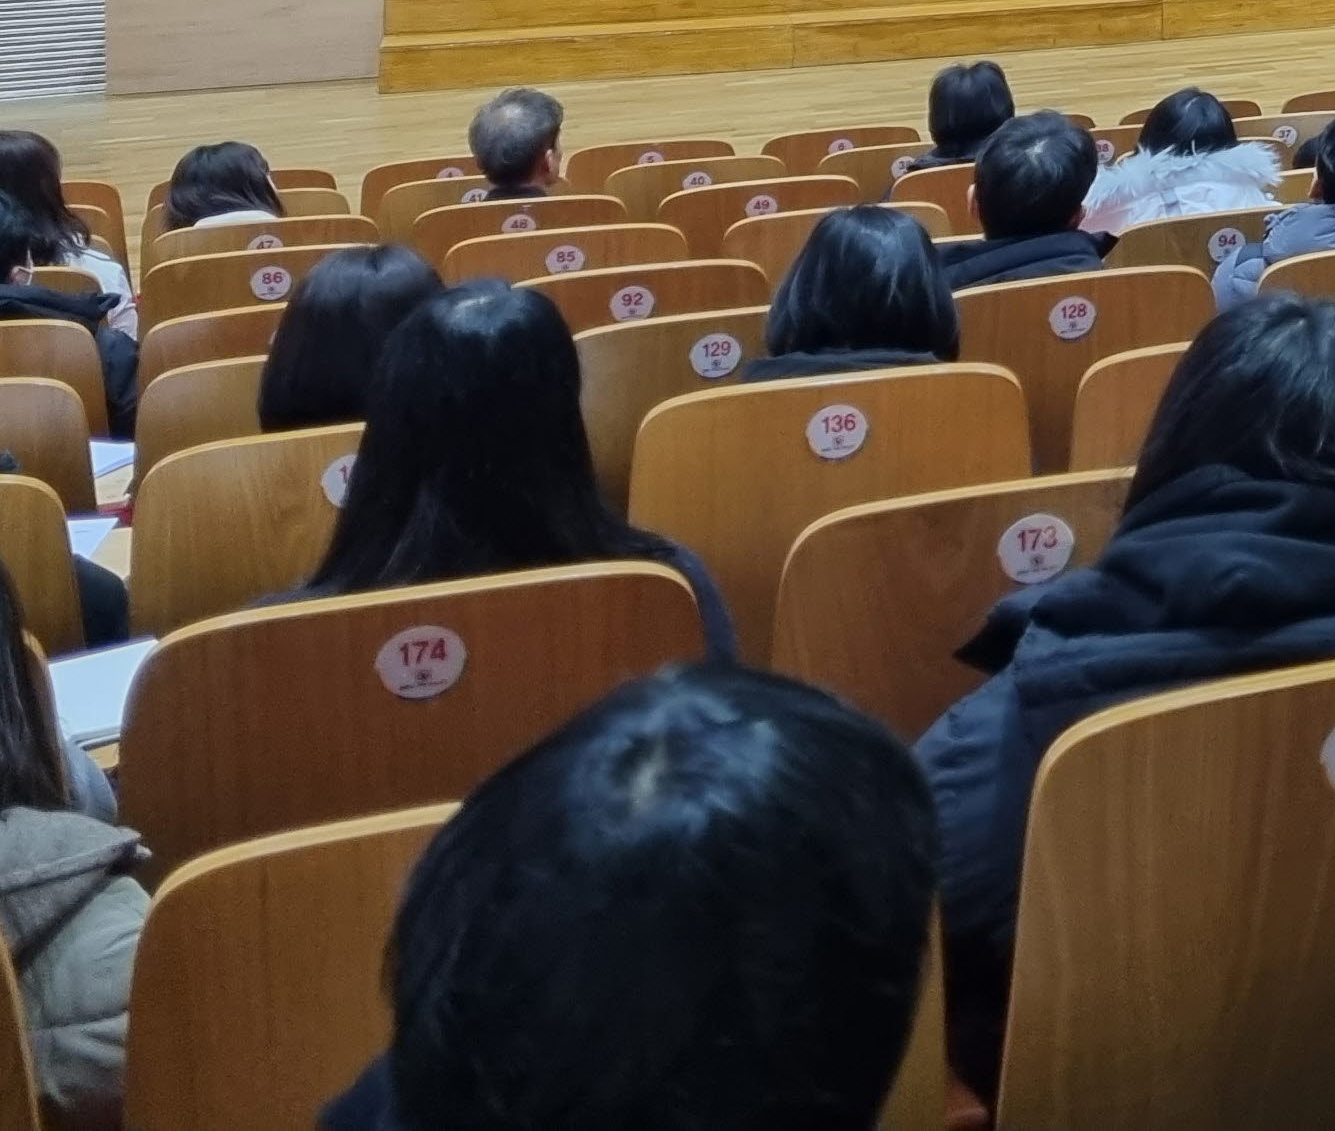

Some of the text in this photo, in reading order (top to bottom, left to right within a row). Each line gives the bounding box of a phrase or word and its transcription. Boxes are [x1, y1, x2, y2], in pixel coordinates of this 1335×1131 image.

[1278, 129, 1291, 139] 37
[690, 176, 706, 186] 40
[754, 199, 771, 212] 49
[509, 219, 527, 230] 48
[256, 240, 275, 250] 47
[1218, 234, 1237, 248] 94
[555, 251, 576, 263] 85
[262, 271, 284, 285] 86
[621, 292, 643, 307] 92
[1061, 303, 1087, 320] 128
[702, 340, 731, 359] 129
[821, 410, 857, 434] 136
[1017, 525, 1058, 552] 173
[398, 637, 447, 667] 174
